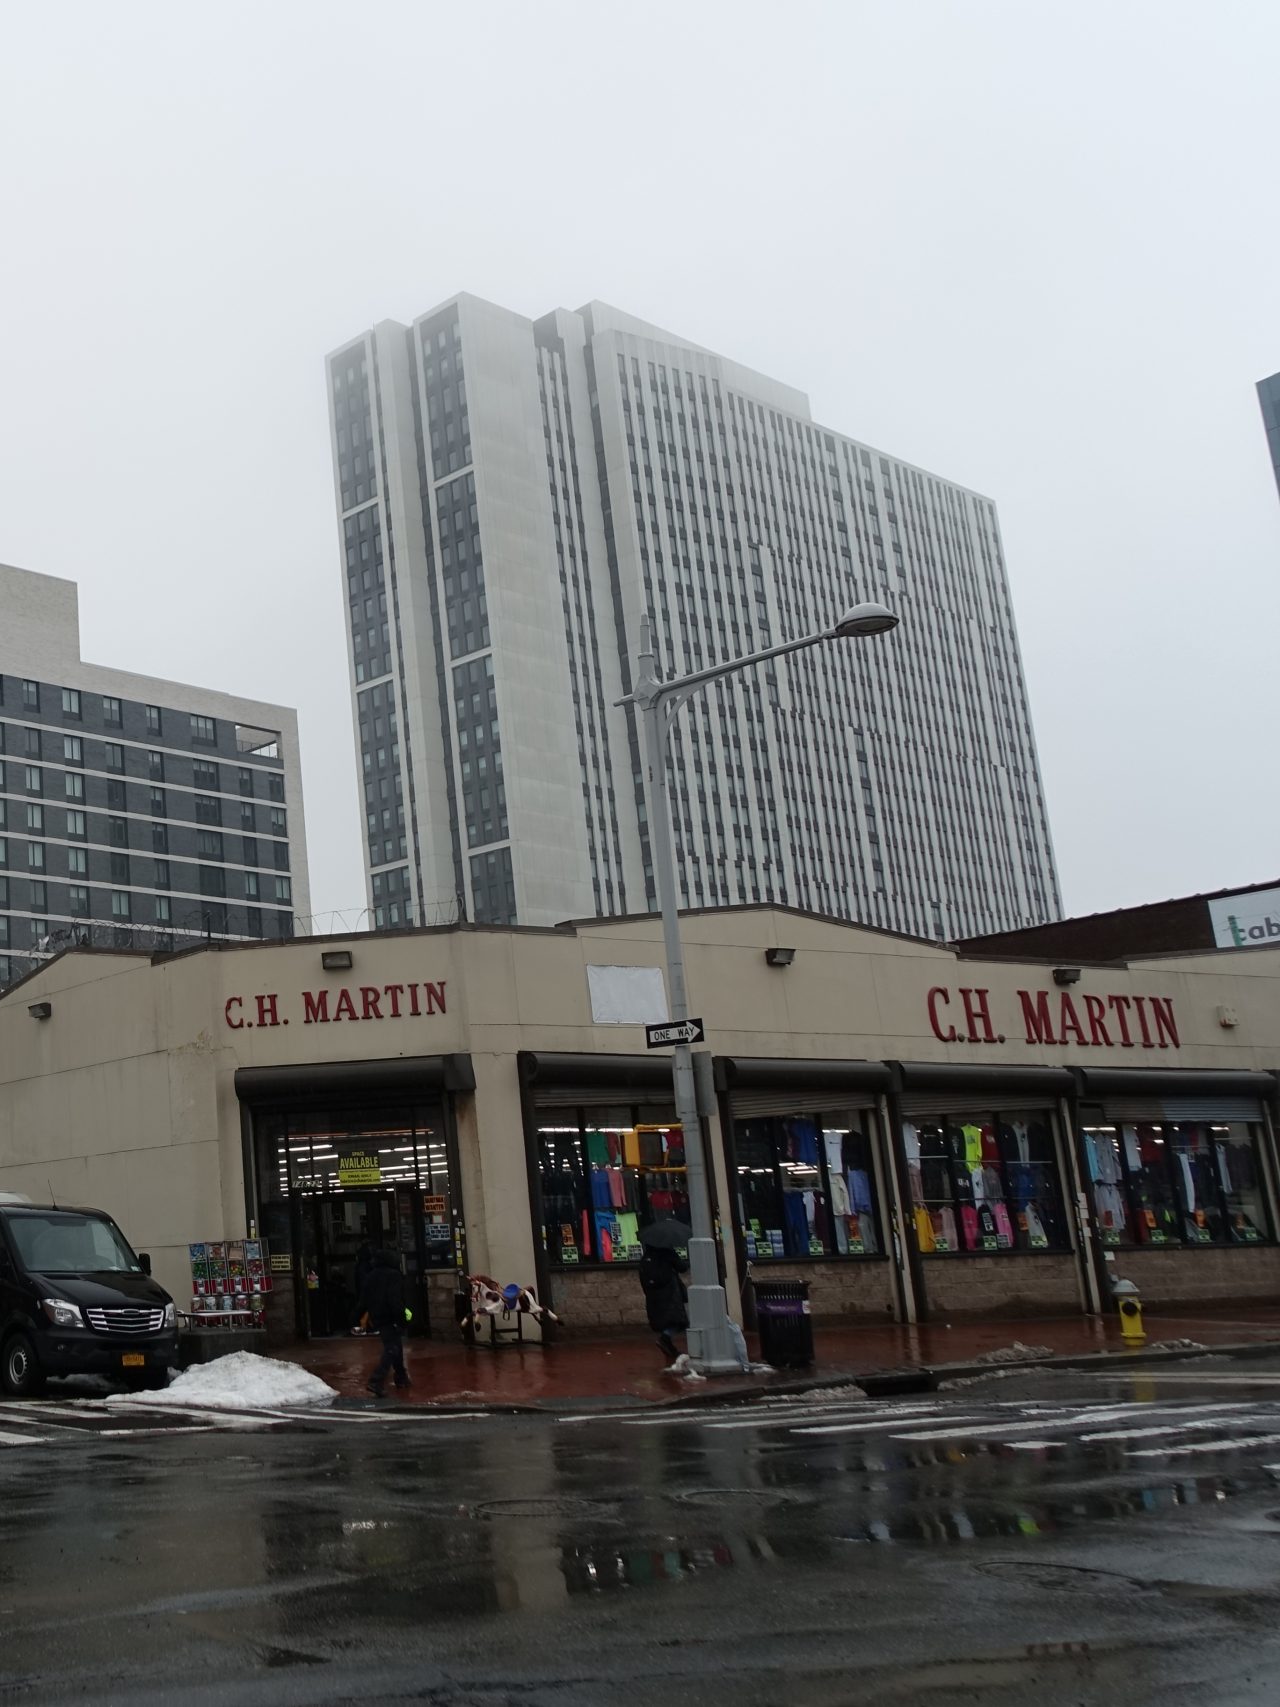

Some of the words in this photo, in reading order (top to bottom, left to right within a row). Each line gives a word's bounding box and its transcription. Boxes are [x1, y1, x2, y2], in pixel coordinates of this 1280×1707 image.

[225, 994, 289, 1029] C.H.
[302, 981, 447, 1024] MARTIN
[927, 986, 1006, 1043] C.H.
[1016, 990, 1180, 1048] MARTIN
[654, 1030, 670, 1041] ONE
[677, 1026, 694, 1038] WAY
[340, 1156, 379, 1169] AVAILABLE
